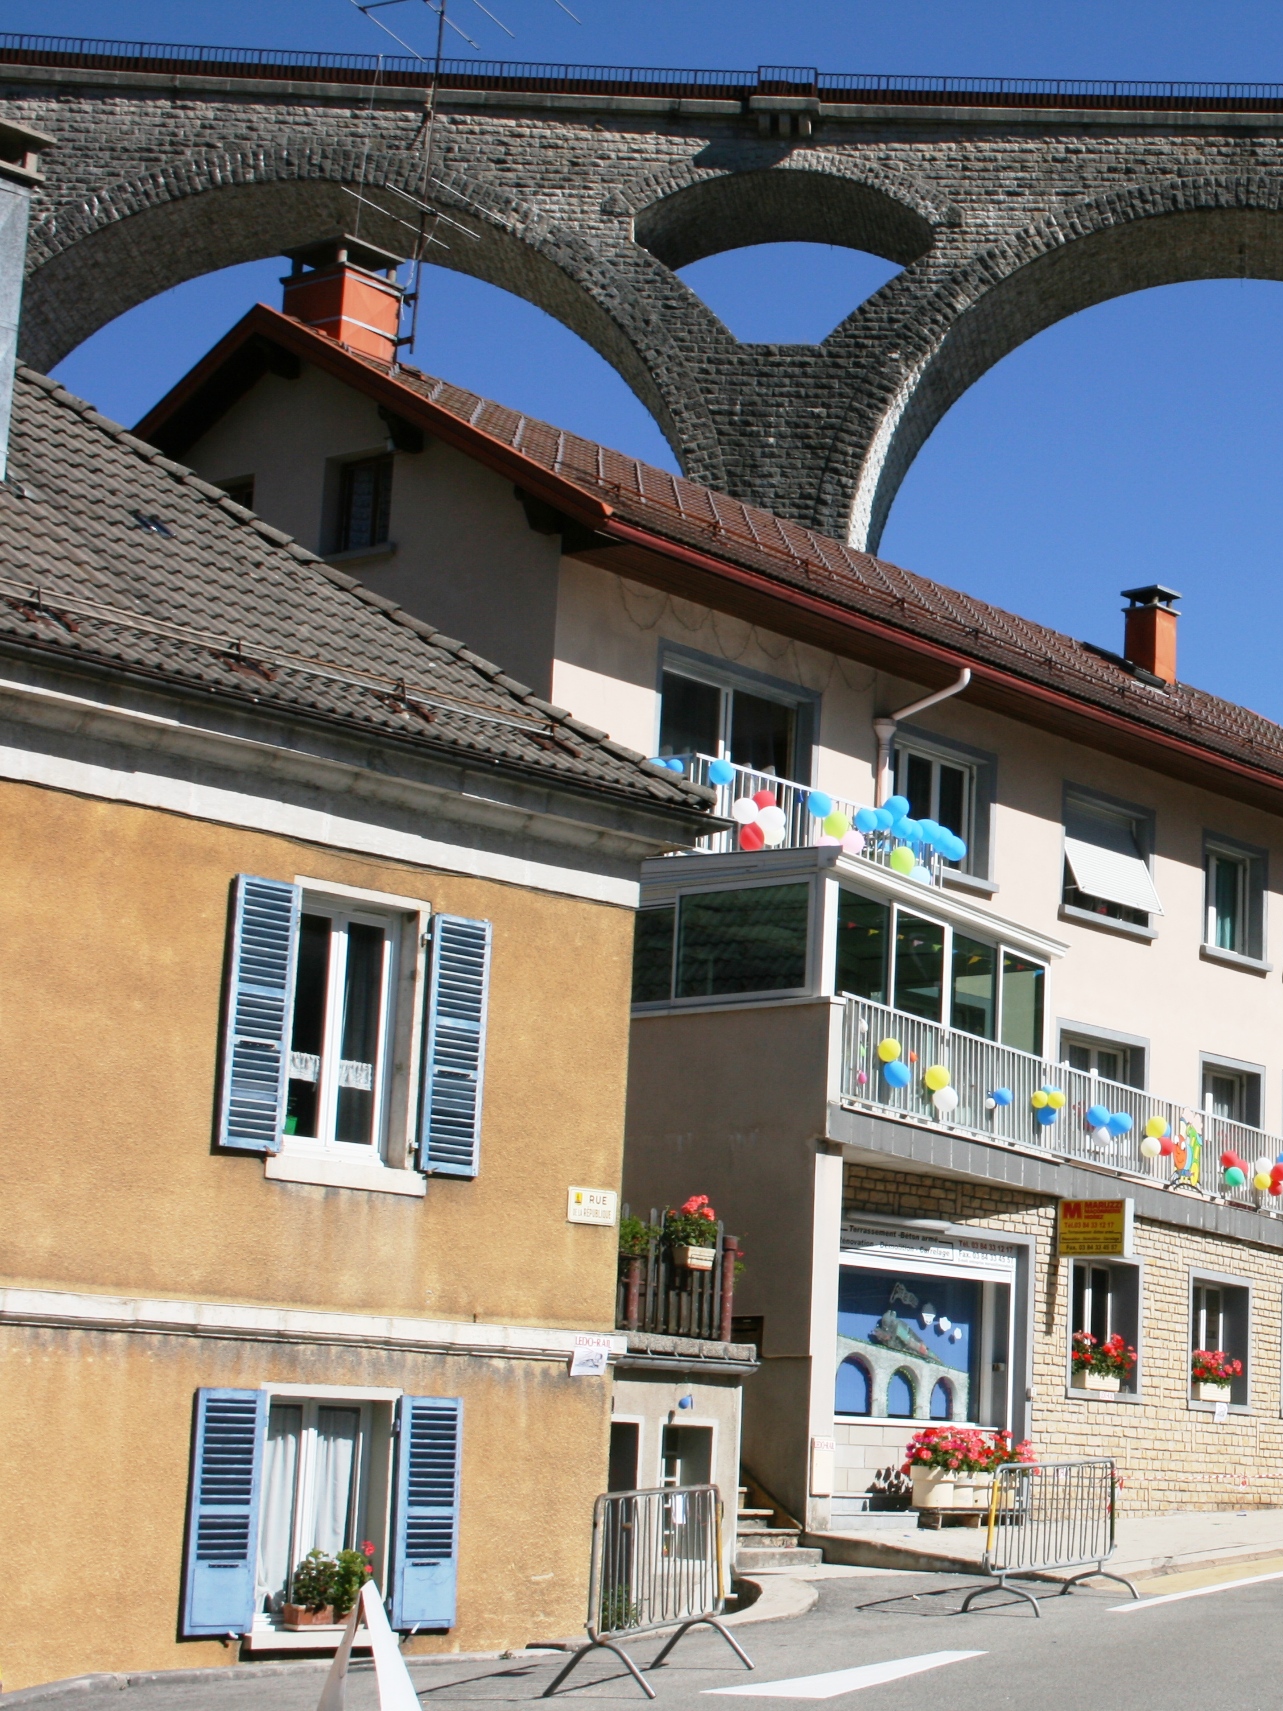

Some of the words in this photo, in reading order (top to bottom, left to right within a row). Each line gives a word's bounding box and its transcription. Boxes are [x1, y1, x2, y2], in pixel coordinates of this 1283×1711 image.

[589, 1194, 607, 1205] RUE
[572, 1208, 577, 1216] DE
[583, 1207, 612, 1219] RÉPUBLIQUE
[1063, 1202, 1082, 1219] M
[848, 1225, 897, 1238] Terrassement
[921, 1235, 939, 1243] armé
[879, 1241, 915, 1252] Démolition
[919, 1246, 950, 1257] Carrelage
[971, 1241, 979, 1249] 03
[980, 1242, 987, 1250] 84
[988, 1243, 996, 1251] 33
[997, 1245, 1005, 1253] 12
[959, 1250, 971, 1258] Fax.
[998, 1255, 1005, 1263] 45
